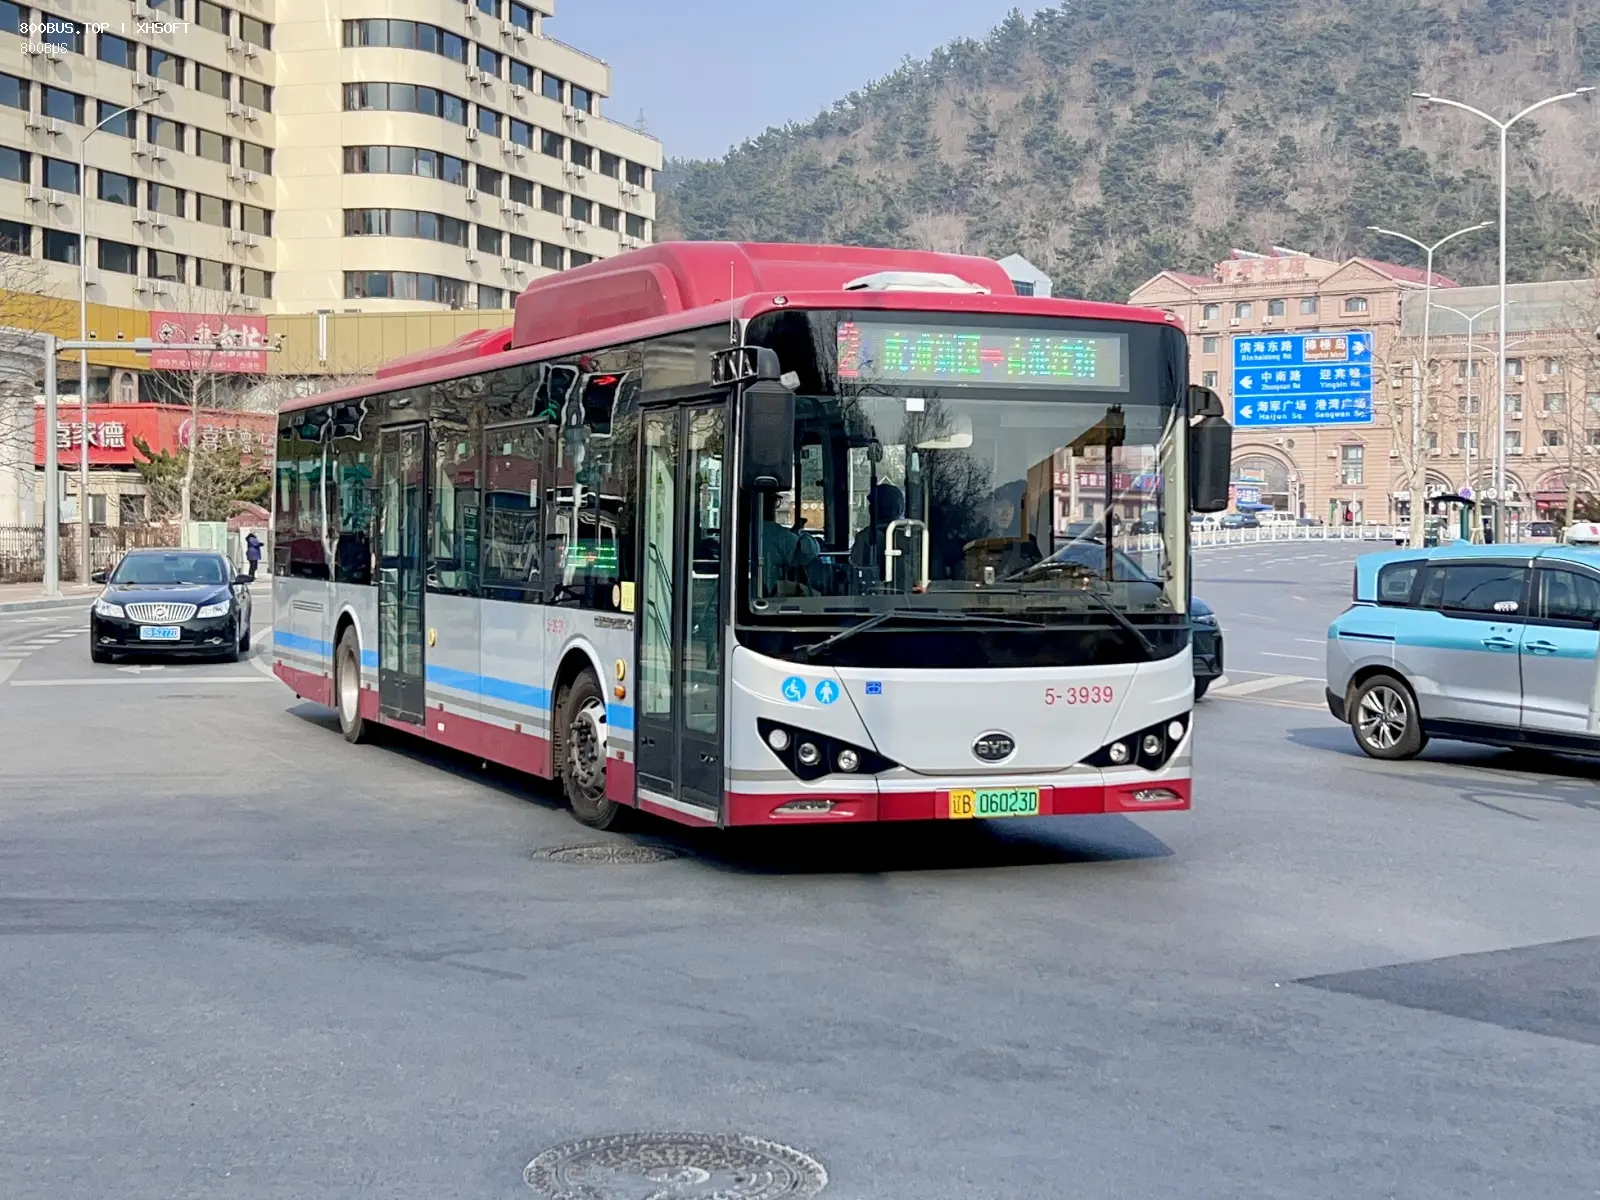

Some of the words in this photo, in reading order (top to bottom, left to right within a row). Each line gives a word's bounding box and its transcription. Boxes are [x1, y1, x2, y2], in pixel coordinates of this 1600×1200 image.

[1239, 340, 1293, 353] 滨海东路
[1241, 354, 1281, 362] Binhaidong
[1260, 370, 1302, 383] 中南路
[1319, 367, 1361, 380] 迎宾路
[1257, 399, 1307, 413] 海军广场
[1314, 397, 1367, 411] 港湾广场
[1259, 413, 1288, 421] Haijun
[1044, 685, 1113, 705] 5-3939
[977, 740, 1012, 755] BYD
[953, 794, 972, 815] 辽B
[979, 791, 1037, 814] 06023D
